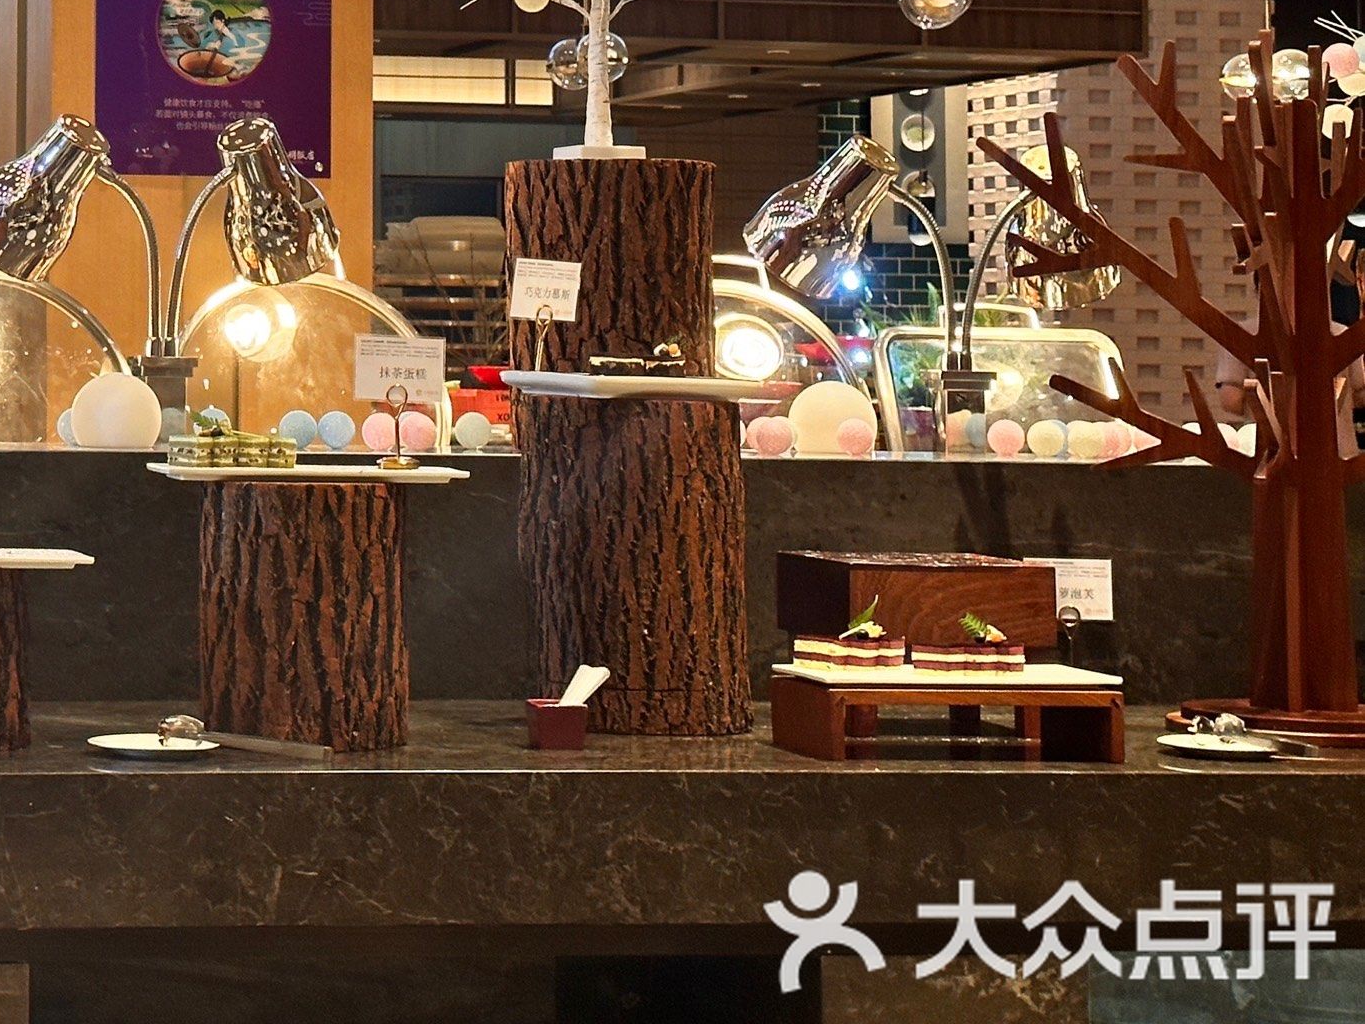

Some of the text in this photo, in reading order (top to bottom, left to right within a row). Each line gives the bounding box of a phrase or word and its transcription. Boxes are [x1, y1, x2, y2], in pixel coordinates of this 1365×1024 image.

[524, 286, 571, 302] 巧克力慕斯
[379, 366, 427, 380] 抹茶蛋糕
